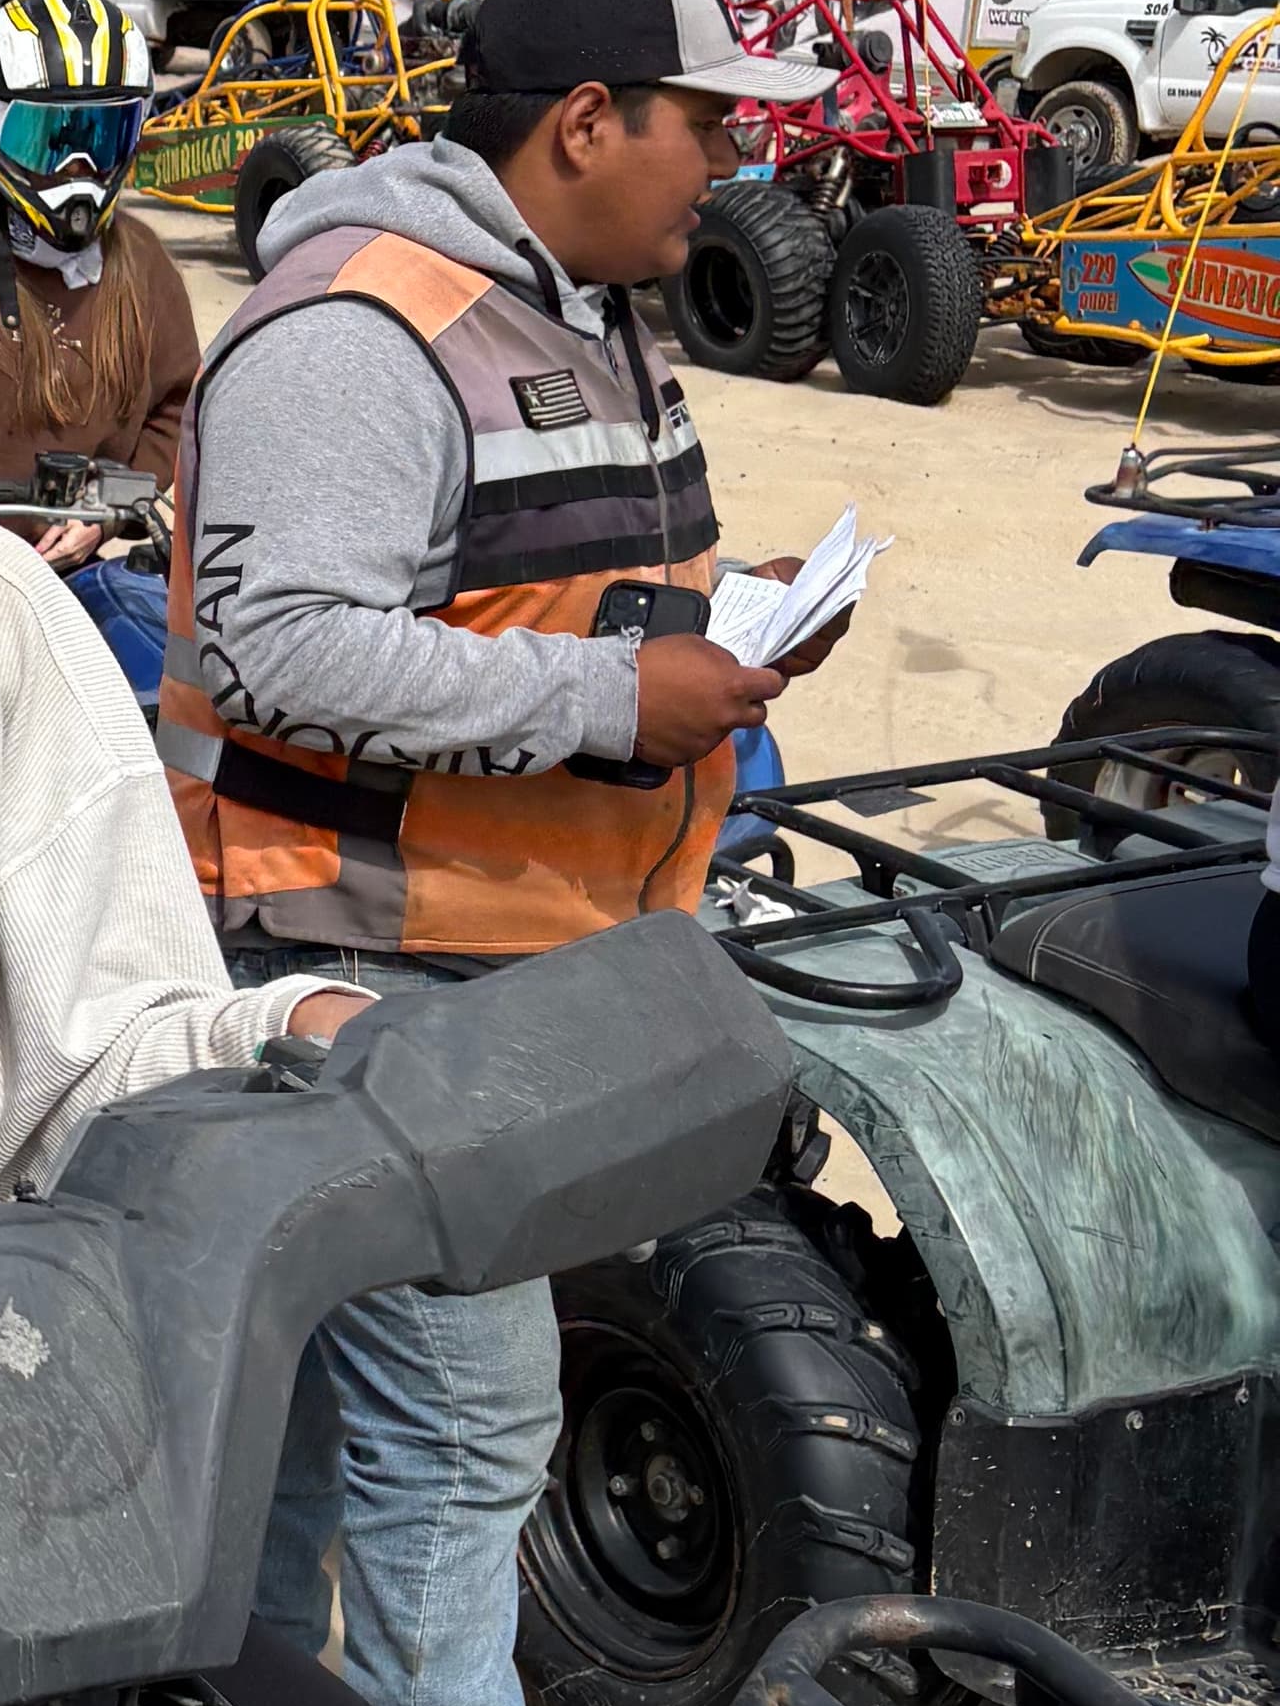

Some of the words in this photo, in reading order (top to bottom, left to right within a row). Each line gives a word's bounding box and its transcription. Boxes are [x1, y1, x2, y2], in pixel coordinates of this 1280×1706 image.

[1144, 3, 1169, 15] S06
[154, 130, 232, 187] SUNBUGGY
[1081, 253, 1117, 285] 229
